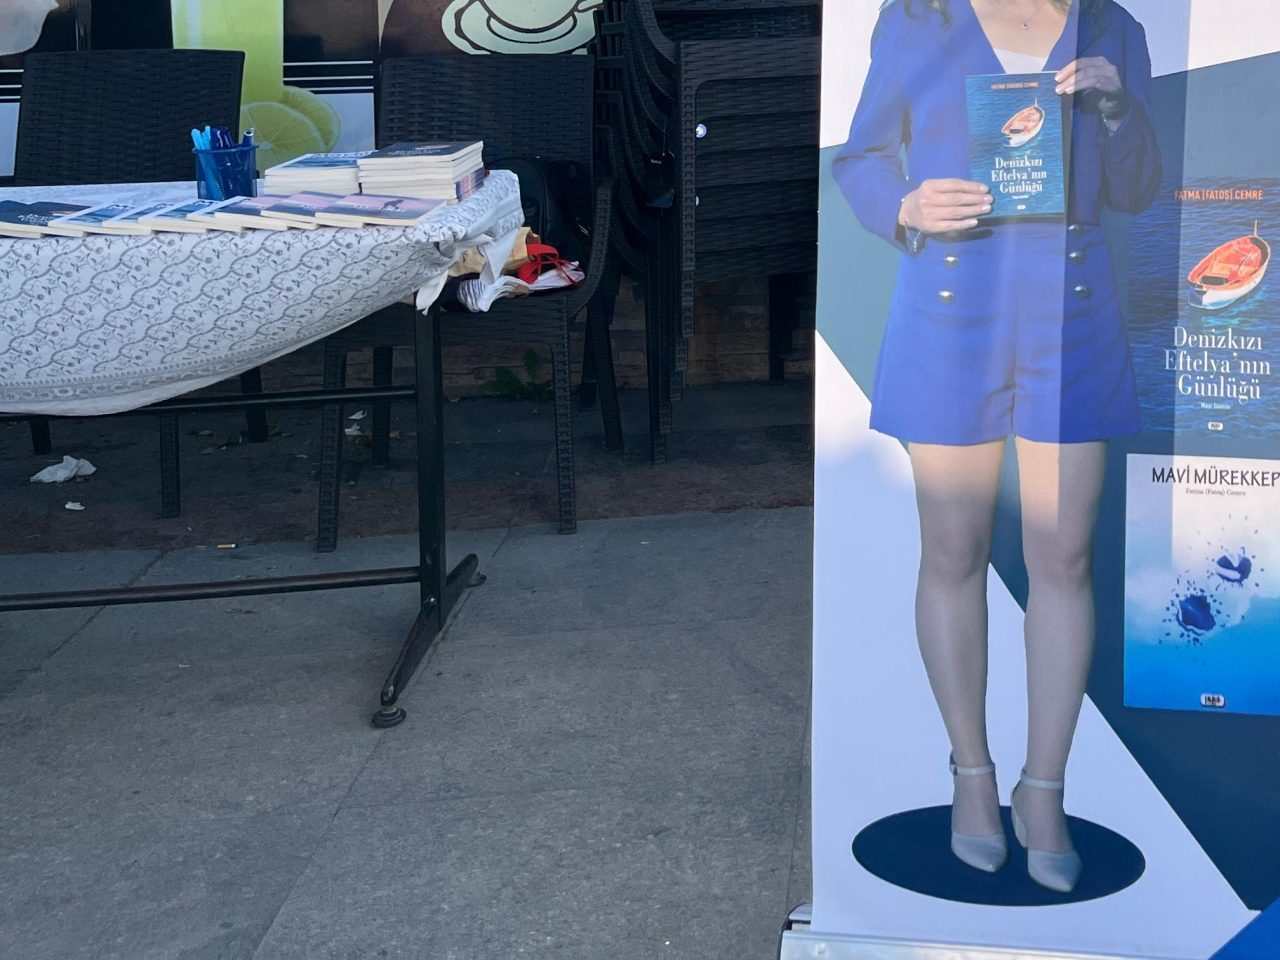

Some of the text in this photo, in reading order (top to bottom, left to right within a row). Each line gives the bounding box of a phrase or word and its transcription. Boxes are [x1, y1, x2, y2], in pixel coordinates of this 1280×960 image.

[1174, 189, 1201, 201] FATMA
[1234, 189, 1264, 200] CEMRE
[1172, 325, 1263, 351] Denizkızı
[1177, 373, 1262, 404] Günlüğü
[1151, 464, 1191, 484] MAVİ
